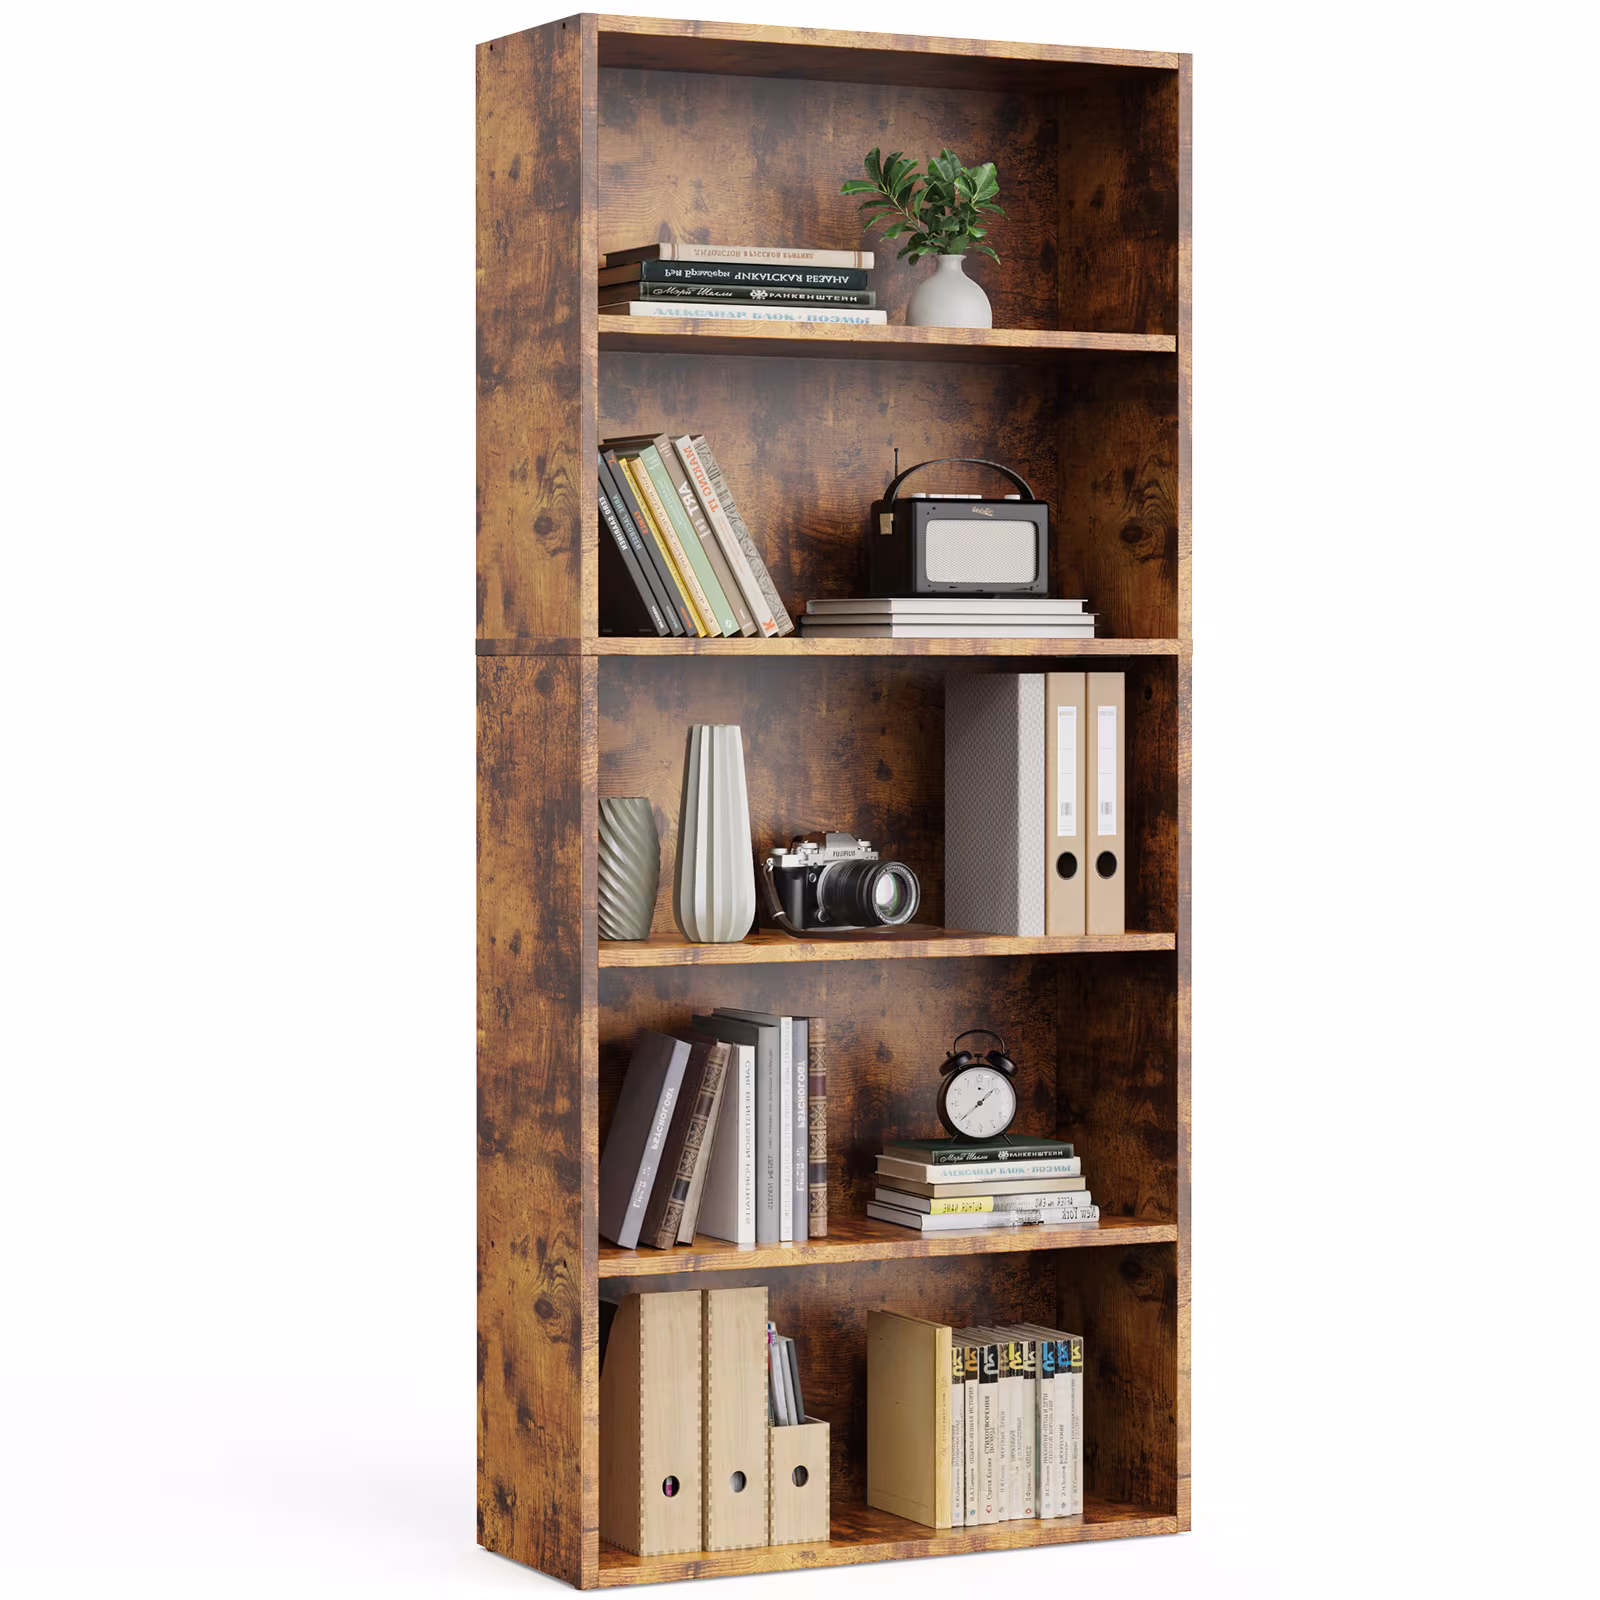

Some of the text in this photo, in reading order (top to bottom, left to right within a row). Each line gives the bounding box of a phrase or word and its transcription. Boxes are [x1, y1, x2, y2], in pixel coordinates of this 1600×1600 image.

[752, 312, 794, 321] БЛОК
[1000, 1167, 1025, 1175] БЛОК
[1032, 1165, 1071, 1173] ПОЭМЫ
